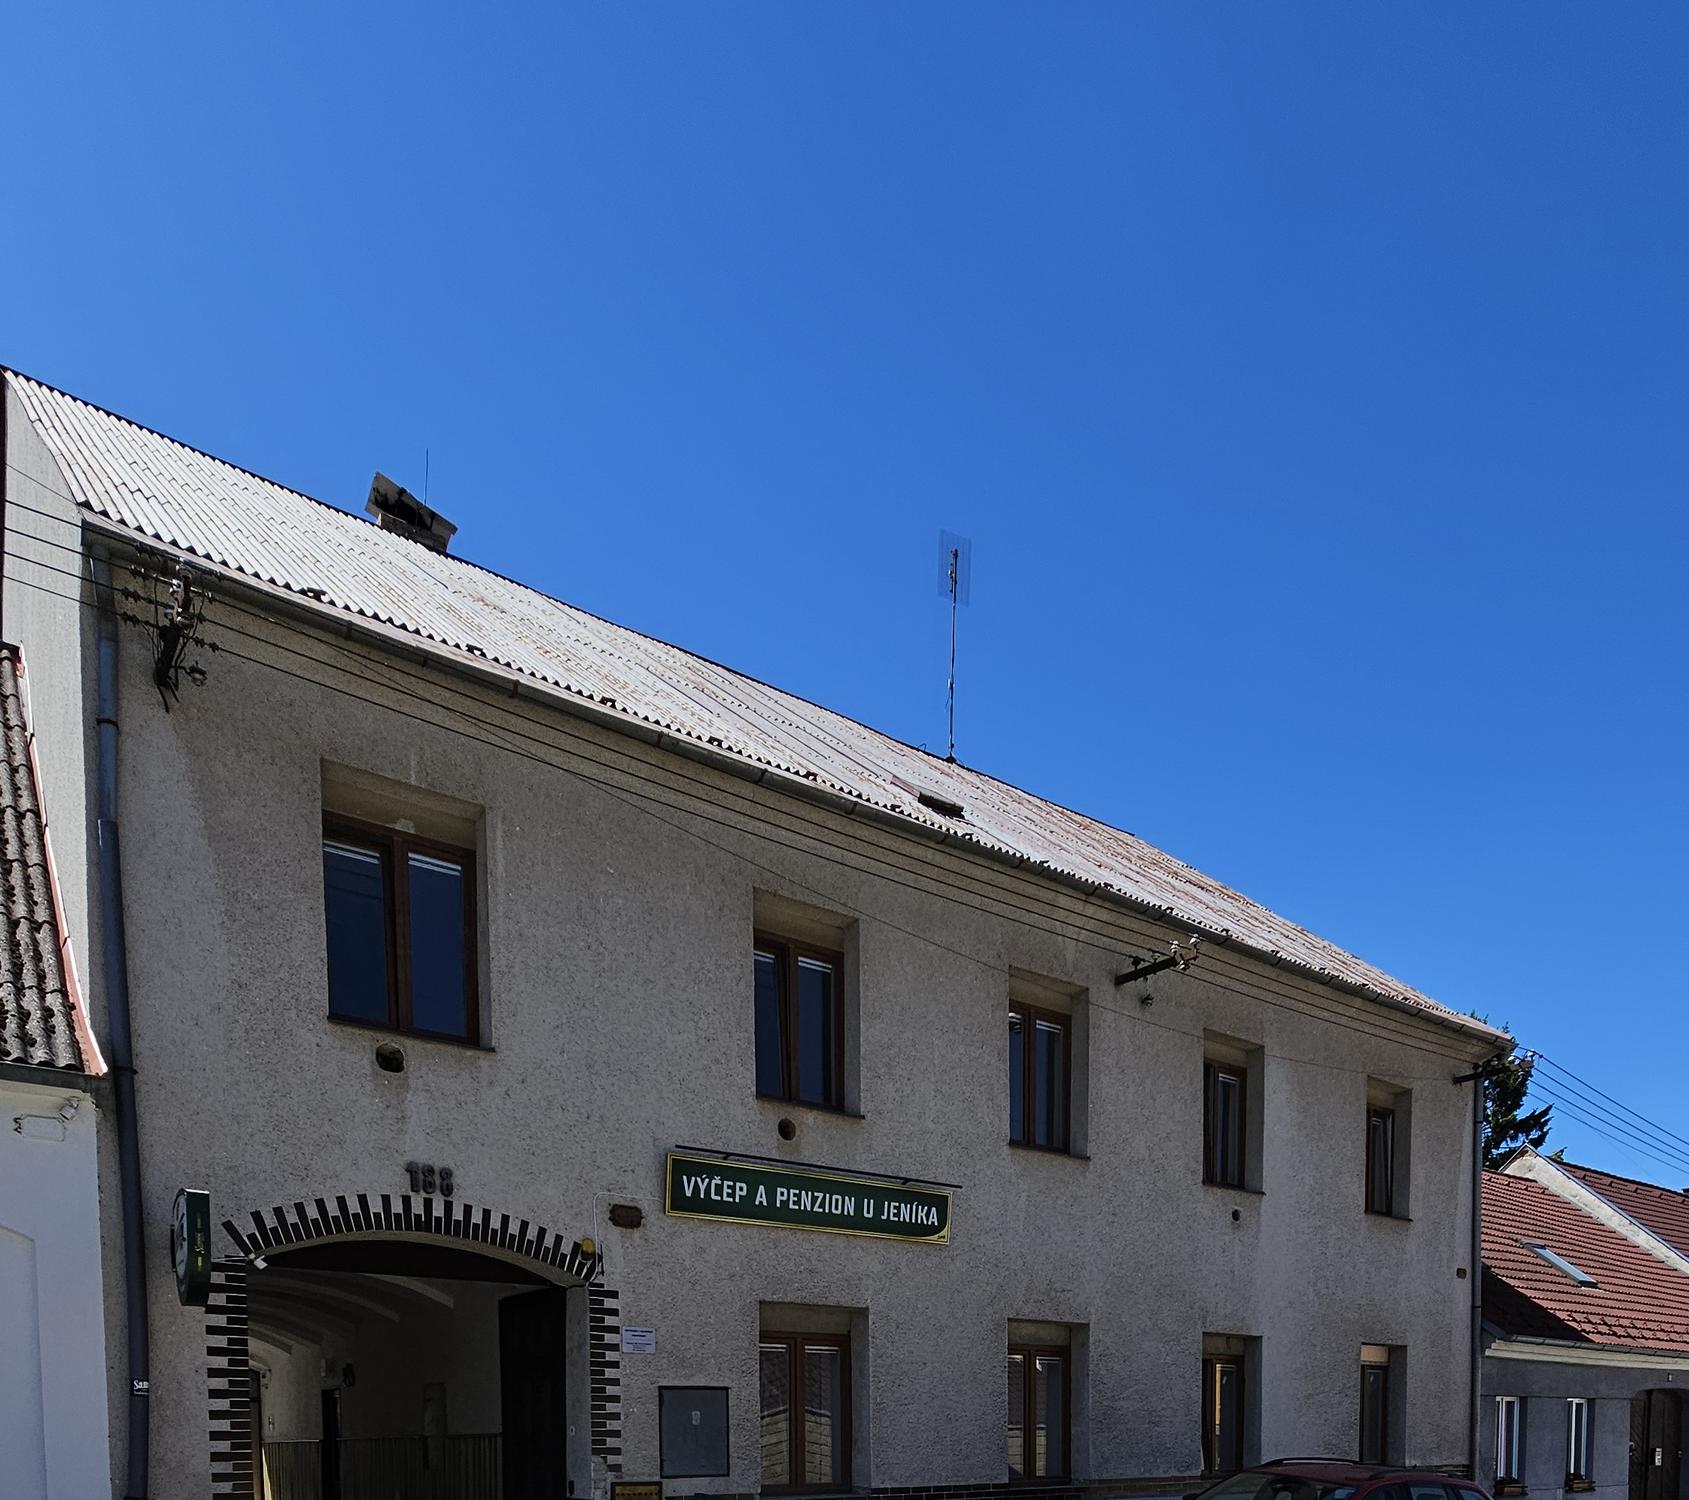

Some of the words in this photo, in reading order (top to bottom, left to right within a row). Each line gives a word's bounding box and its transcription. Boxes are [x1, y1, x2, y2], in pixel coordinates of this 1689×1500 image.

[406, 1161, 453, 1197] 188
[681, 1174, 748, 1203] VÝČEP
[754, 1184, 768, 1207] A
[775, 1186, 856, 1217] PENZION
[862, 1198, 875, 1219] U
[880, 1201, 939, 1227] JENÍKA
